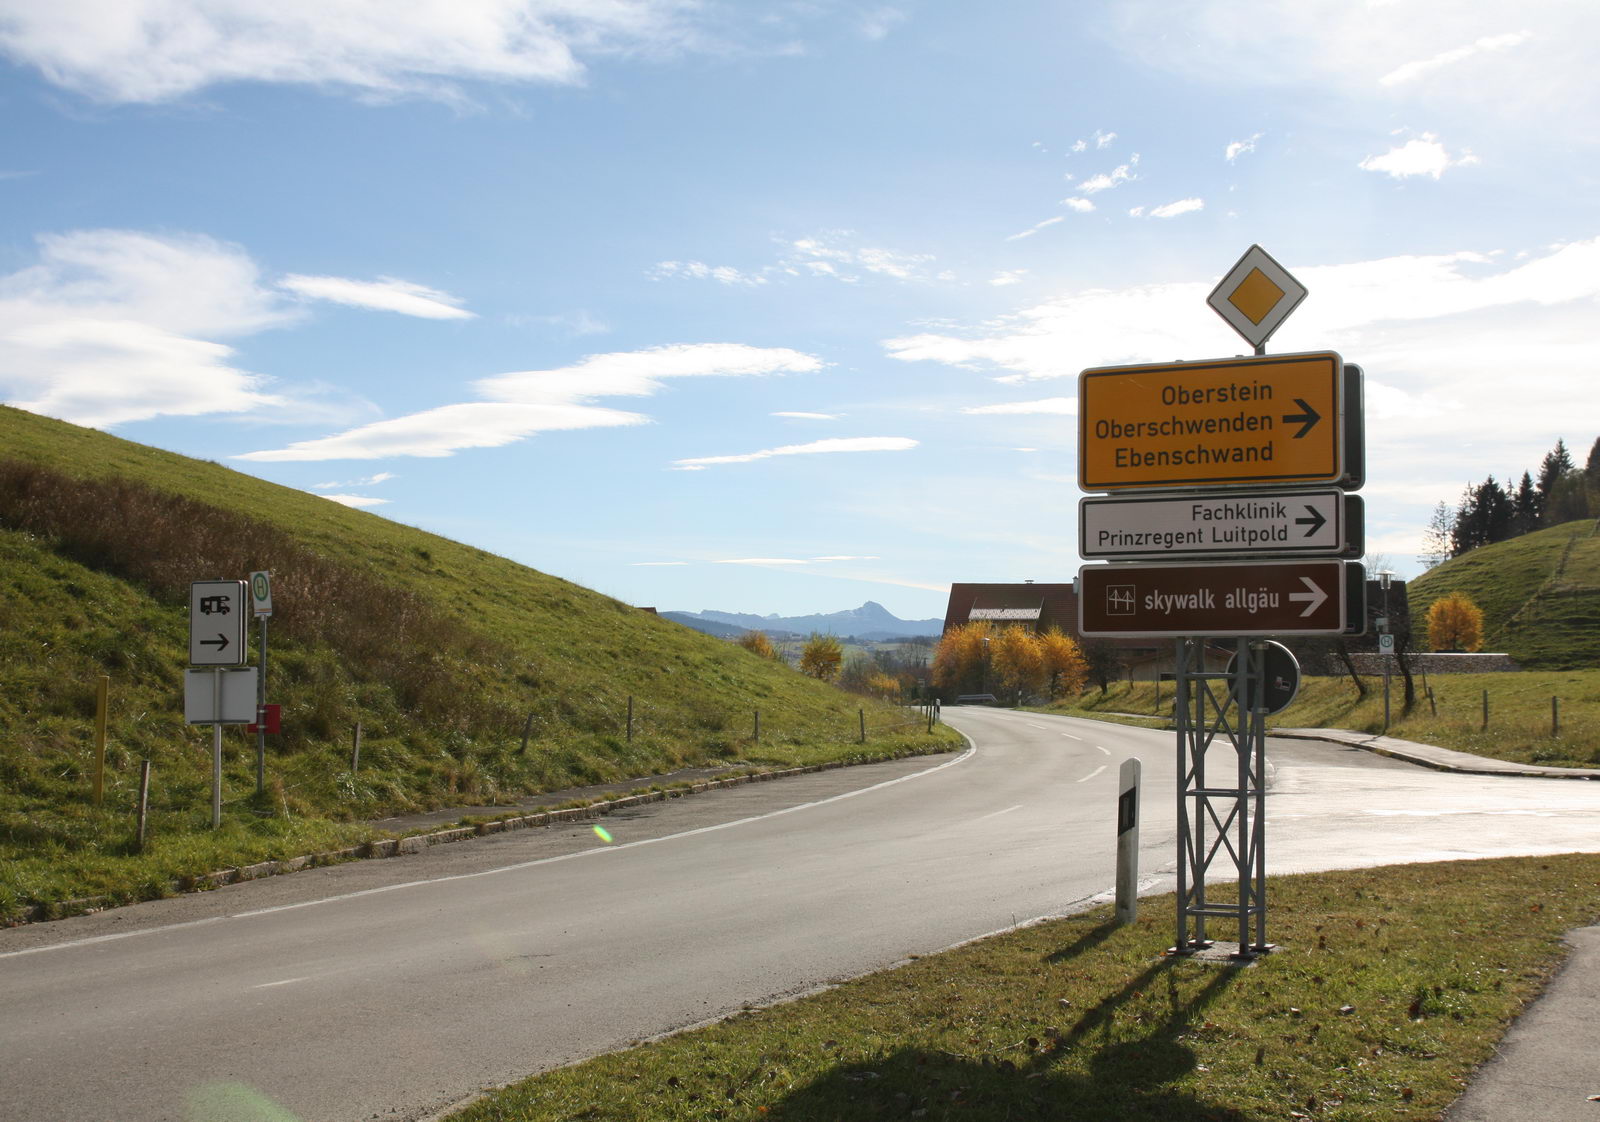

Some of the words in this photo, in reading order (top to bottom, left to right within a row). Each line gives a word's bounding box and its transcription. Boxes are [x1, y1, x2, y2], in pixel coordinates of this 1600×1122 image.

[1162, 382, 1272, 406] Oberstein
[1095, 412, 1272, 439] Oberschwenden
[1115, 442, 1273, 468] Ebenschwand
[1192, 502, 1287, 521] Fachklinik
[1099, 528, 1203, 548] Prinzregent
[1212, 525, 1288, 547] Luitpold
[1145, 590, 1215, 616] skywalk
[1225, 587, 1279, 613] allgäu
